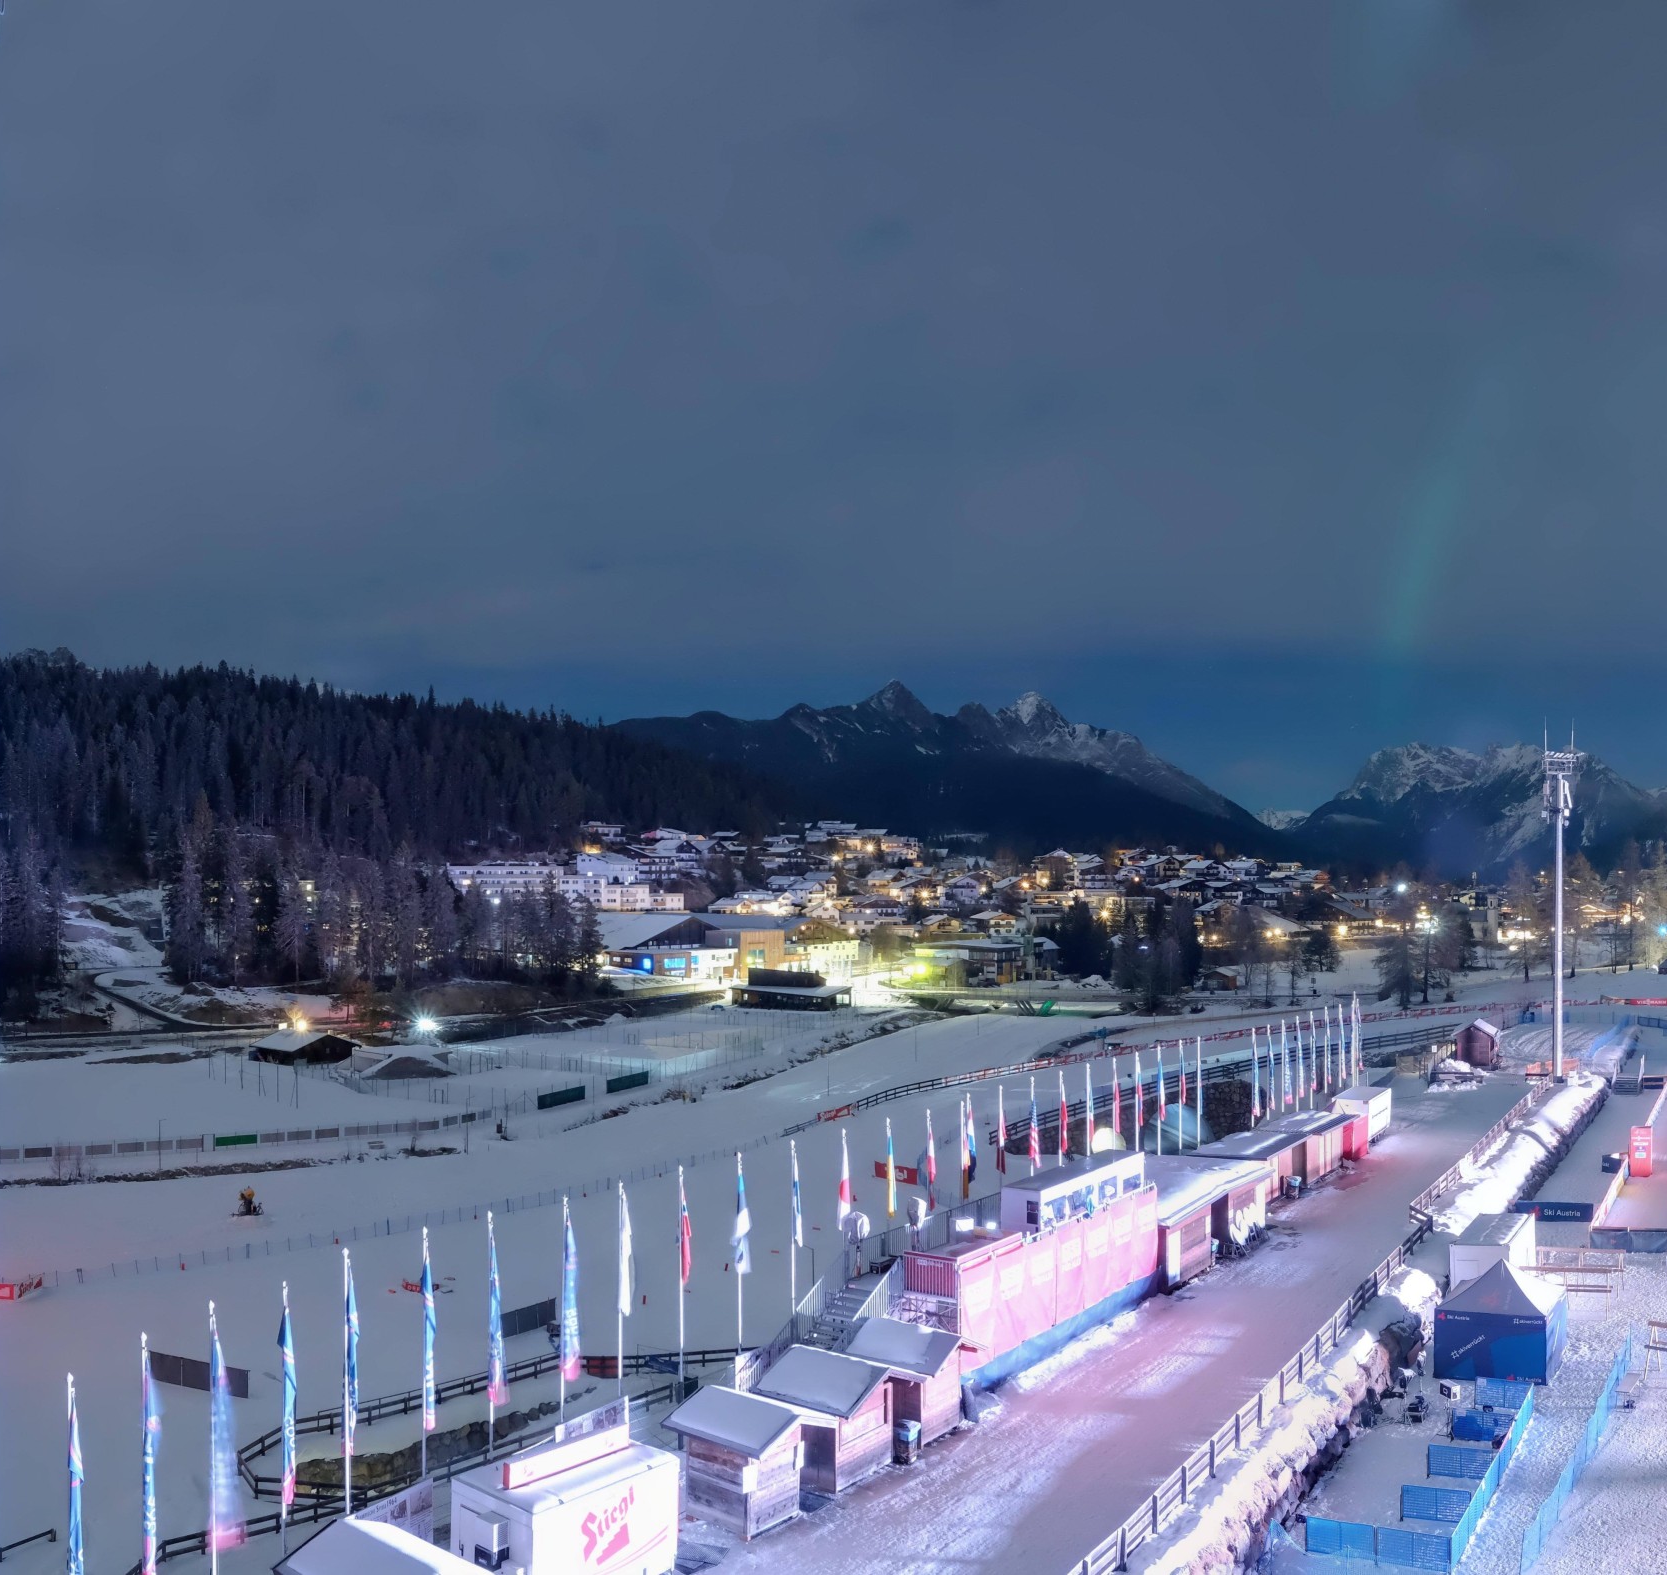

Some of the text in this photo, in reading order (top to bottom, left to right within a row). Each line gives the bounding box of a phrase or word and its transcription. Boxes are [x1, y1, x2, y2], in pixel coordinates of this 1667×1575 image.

[1543, 1208, 1581, 1217] Ski Austria
[1450, 1334, 1486, 1360] #skiverrückt
[581, 1485, 634, 1563] Stiegl
